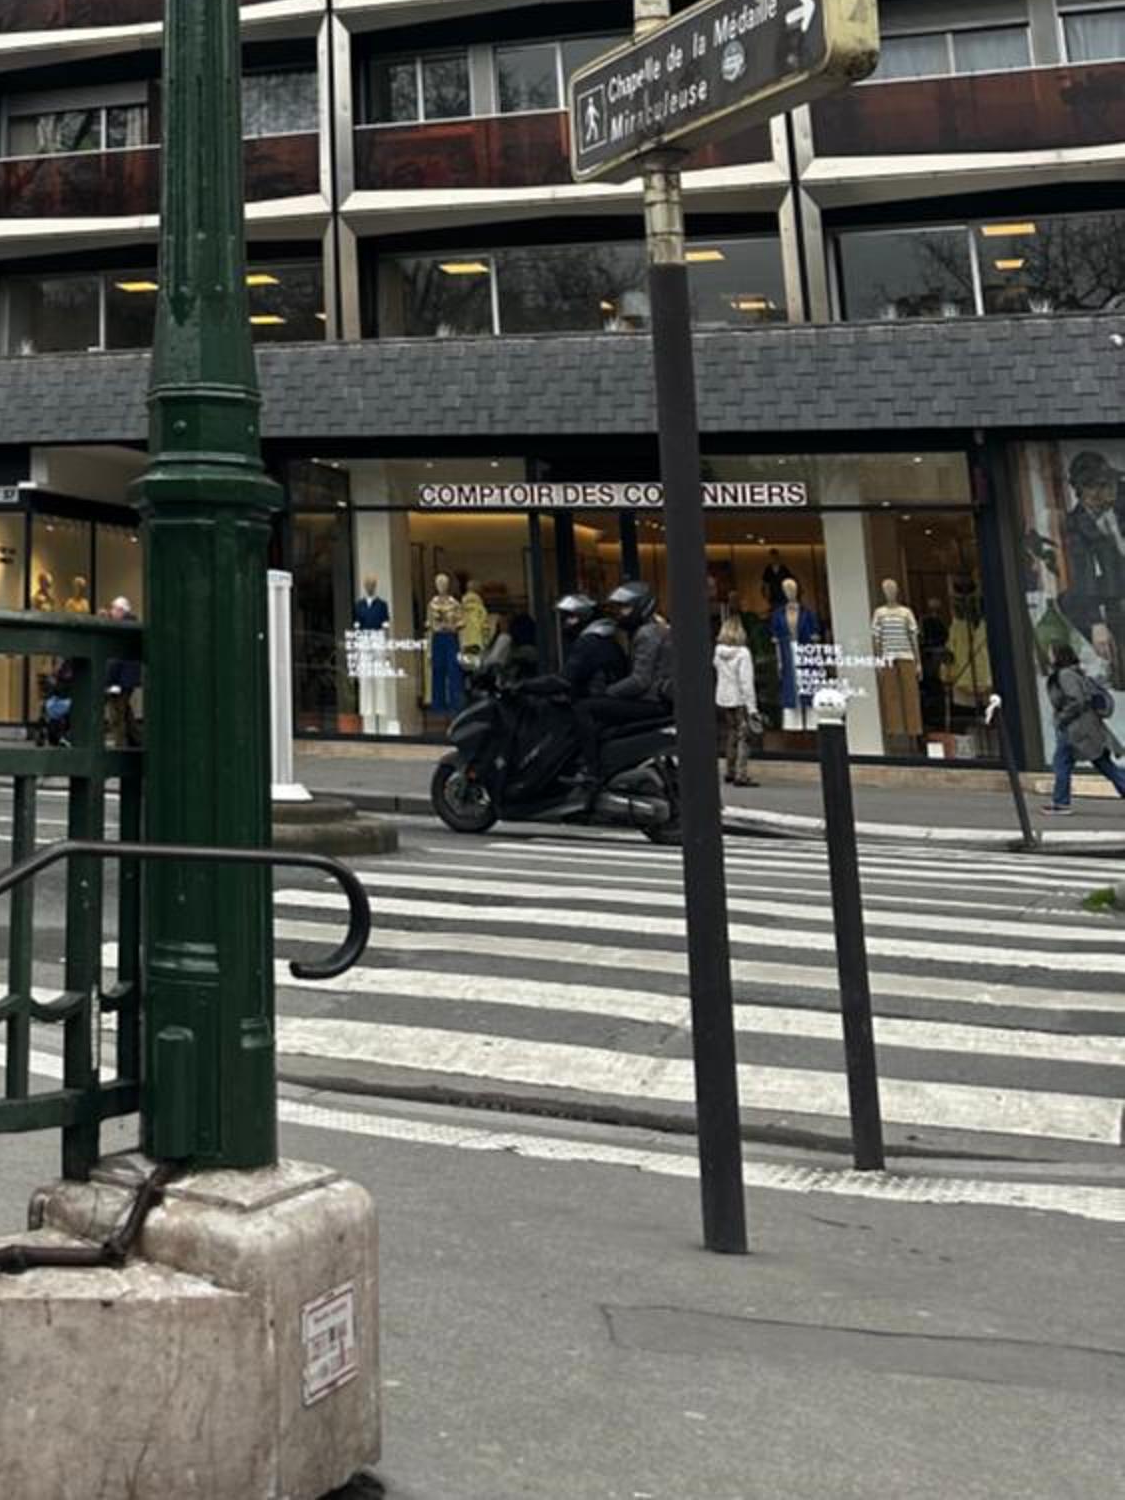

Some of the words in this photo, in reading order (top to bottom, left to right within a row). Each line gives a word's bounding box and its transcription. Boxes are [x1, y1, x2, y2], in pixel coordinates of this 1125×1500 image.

[607, 56, 662, 104] Chapelle
[666, 44, 684, 73] de
[692, 32, 707, 59] la
[420, 484, 555, 505] COMPTOIR
[562, 484, 615, 505] DES
[624, 484, 806, 504] CONNIERS
